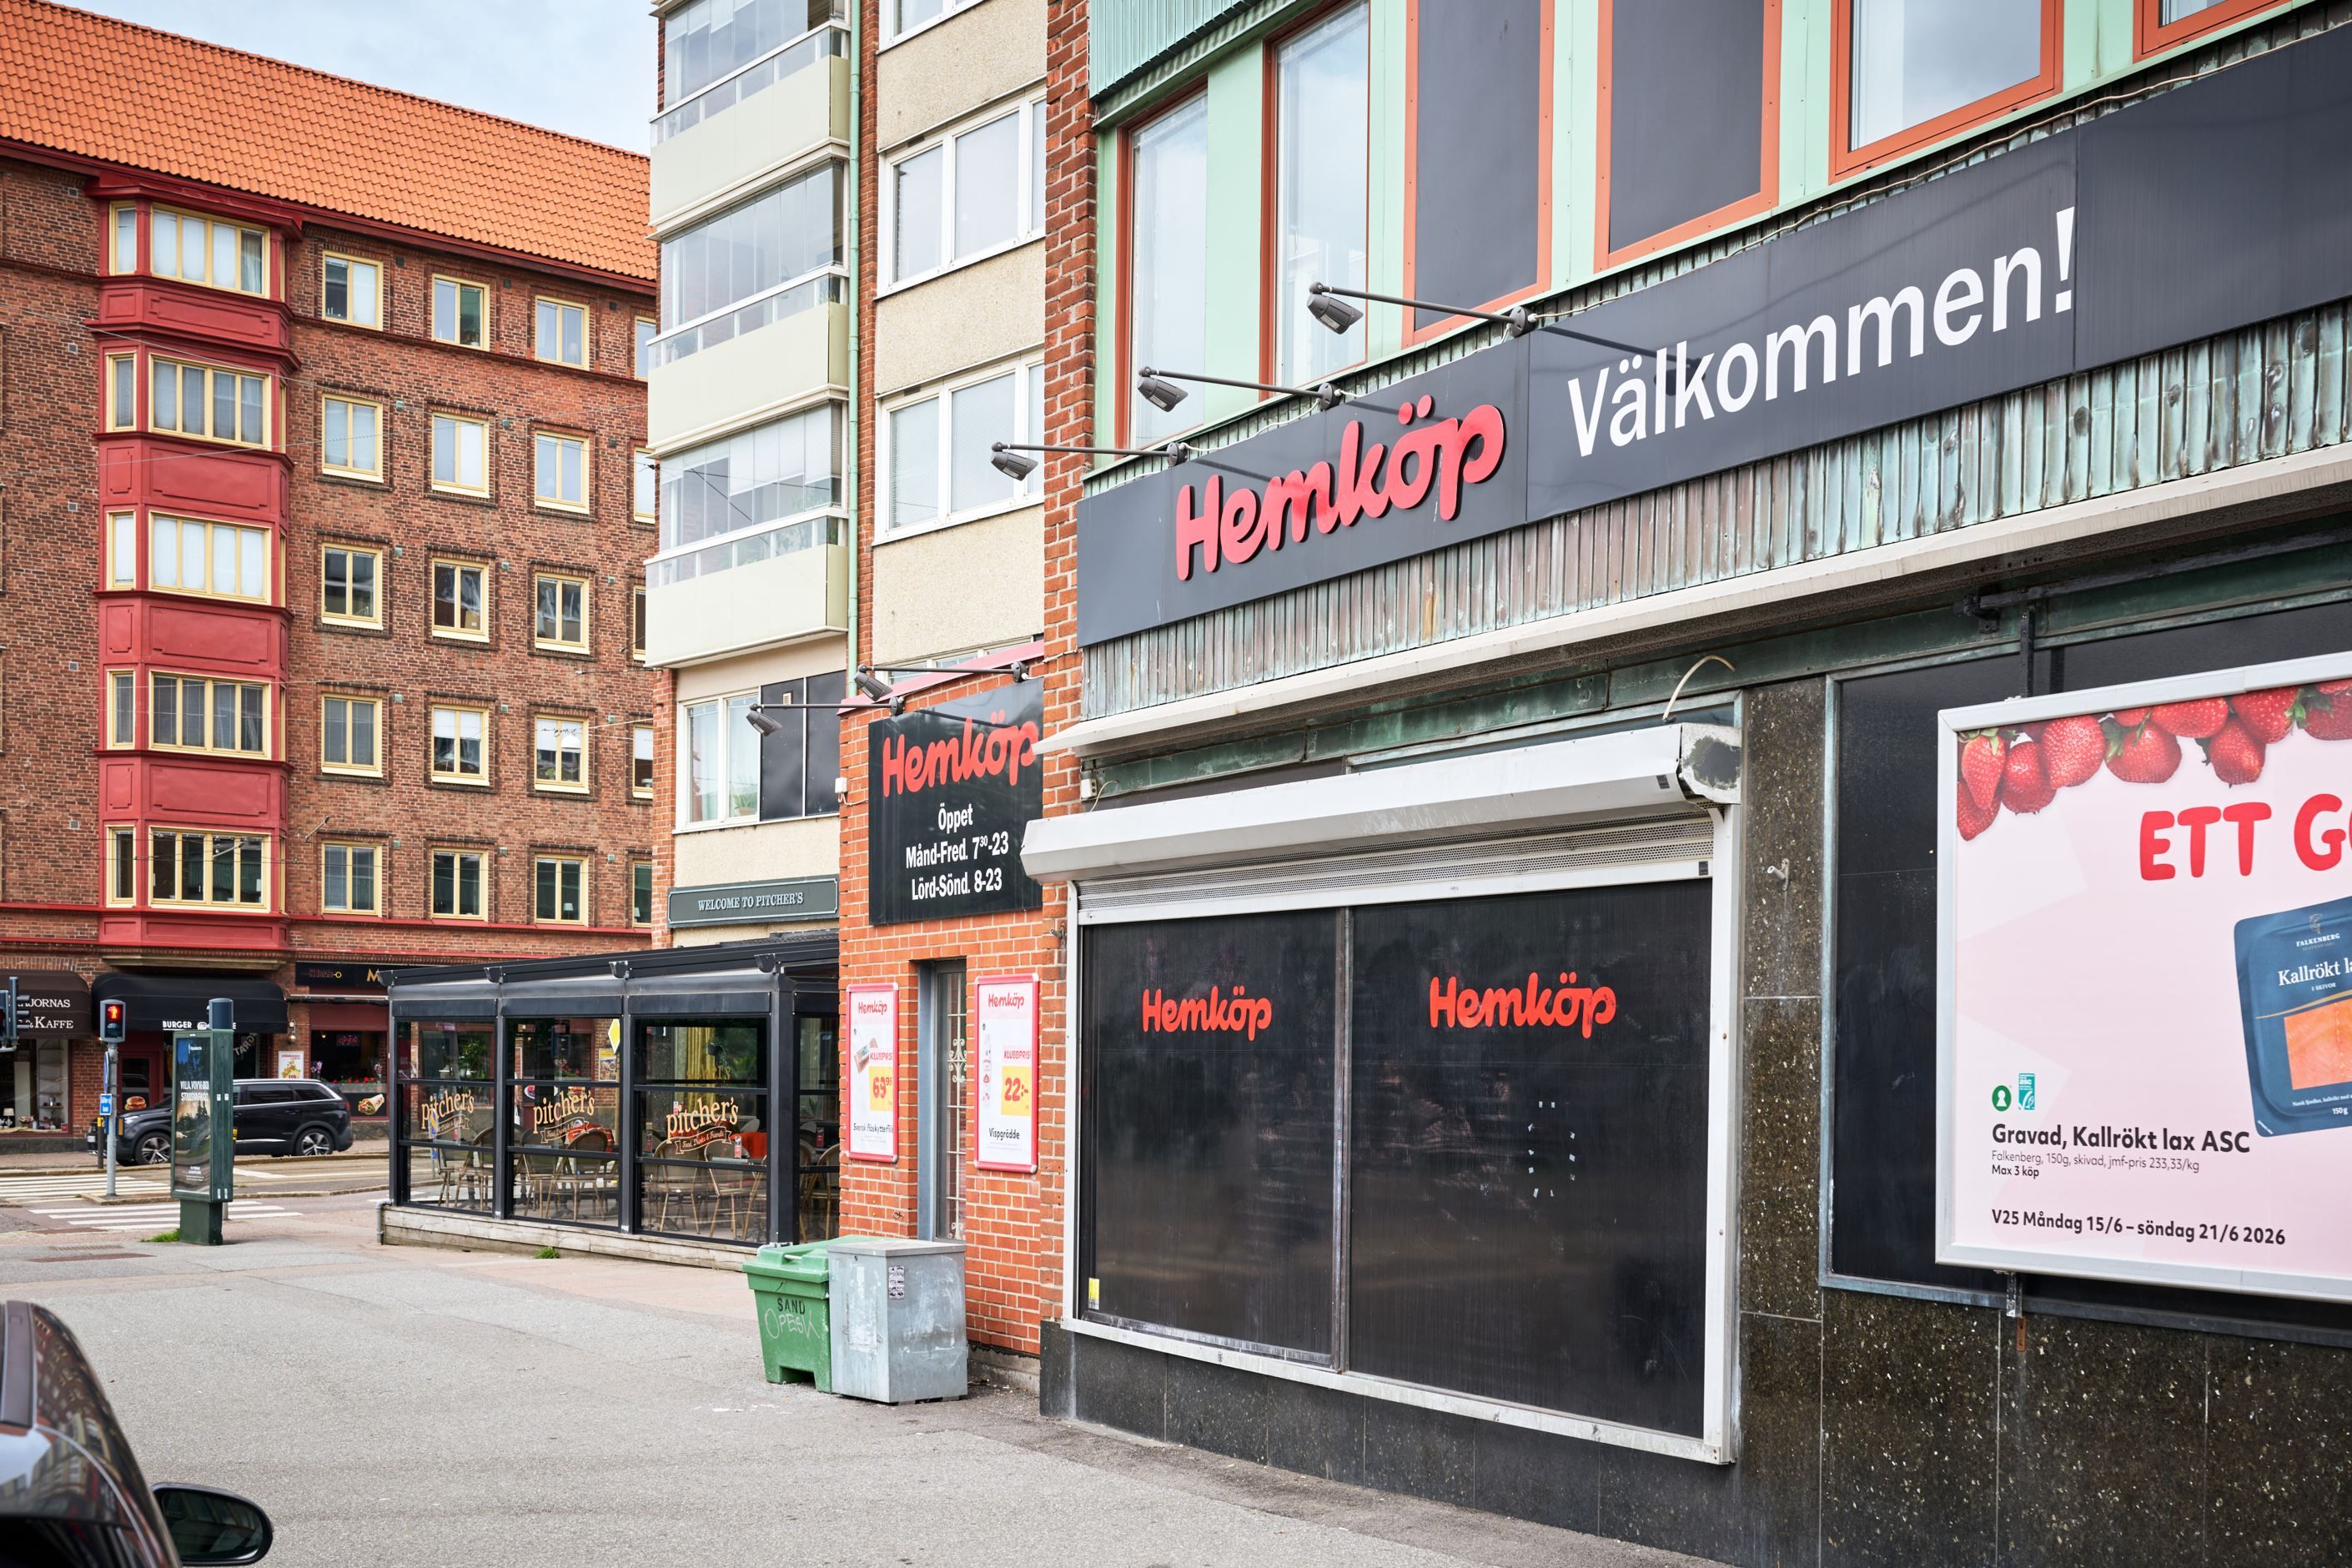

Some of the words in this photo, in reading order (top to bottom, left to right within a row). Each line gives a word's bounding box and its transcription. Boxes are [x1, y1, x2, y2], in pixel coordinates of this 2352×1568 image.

[1568, 207, 2075, 457] Välkommen!
[1176, 395, 1505, 582] Hemköp
[882, 709, 1038, 797] Hemköp
[937, 802, 973, 833] Öppet
[2139, 802, 2271, 881] ETT
[2294, 793, 2352, 872] G
[906, 838, 968, 868] Månd-Fred.
[912, 872, 970, 901] Lörd-Sönd.
[974, 867, 1002, 893] 8-23
[698, 897, 740, 911] WELCOME
[742, 896, 754, 907] TO
[756, 892, 803, 907] PITCHER'S
[2296, 932, 2340, 947] FALKENBERG
[2278, 961, 2341, 986] Kallrökt
[2314, 983, 2337, 991] SKIVOR
[18, 998, 71, 1008] JORNAS
[858, 1000, 887, 1015] Hemköp
[988, 992, 1024, 1009] Hemköp
[1143, 986, 1272, 1042] Hemköp
[1430, 972, 1616, 1039] Hemköp
[1004, 1077, 1029, 1102] 22:-
[421, 1088, 475, 1129] pitcher's
[533, 1089, 595, 1133] pitcher's
[666, 1096, 739, 1143] pitcher's
[989, 1128, 1020, 1141] Vispgrädde
[1993, 1123, 2067, 1149] Gravad,
[2073, 1126, 2158, 1149] Kallrökt
[2163, 1128, 2195, 1151] lax
[2201, 1130, 2250, 1153] ASC
[1992, 1150, 2043, 1166] Falkenberg,
[2046, 1153, 2071, 1167] 150g,
[2073, 1154, 2106, 1168] skivad,
[2108, 1155, 2147, 1169] jmf-pris
[2149, 1157, 2199, 1173] 233,33/kg
[1992, 1164, 2012, 1175] Max
[2014, 1166, 2020, 1176] 3
[2022, 1165, 2039, 1179] köp
[1992, 1209, 2019, 1225] V25
[2023, 1210, 2083, 1234] Måndag
[2087, 1216, 2123, 1234] 15/6
[2137, 1220, 2194, 1243] söndag
[2199, 1224, 2239, 1243] 21/6
[2243, 1227, 2285, 1245] 2026
[777, 1298, 806, 1315] SAND
